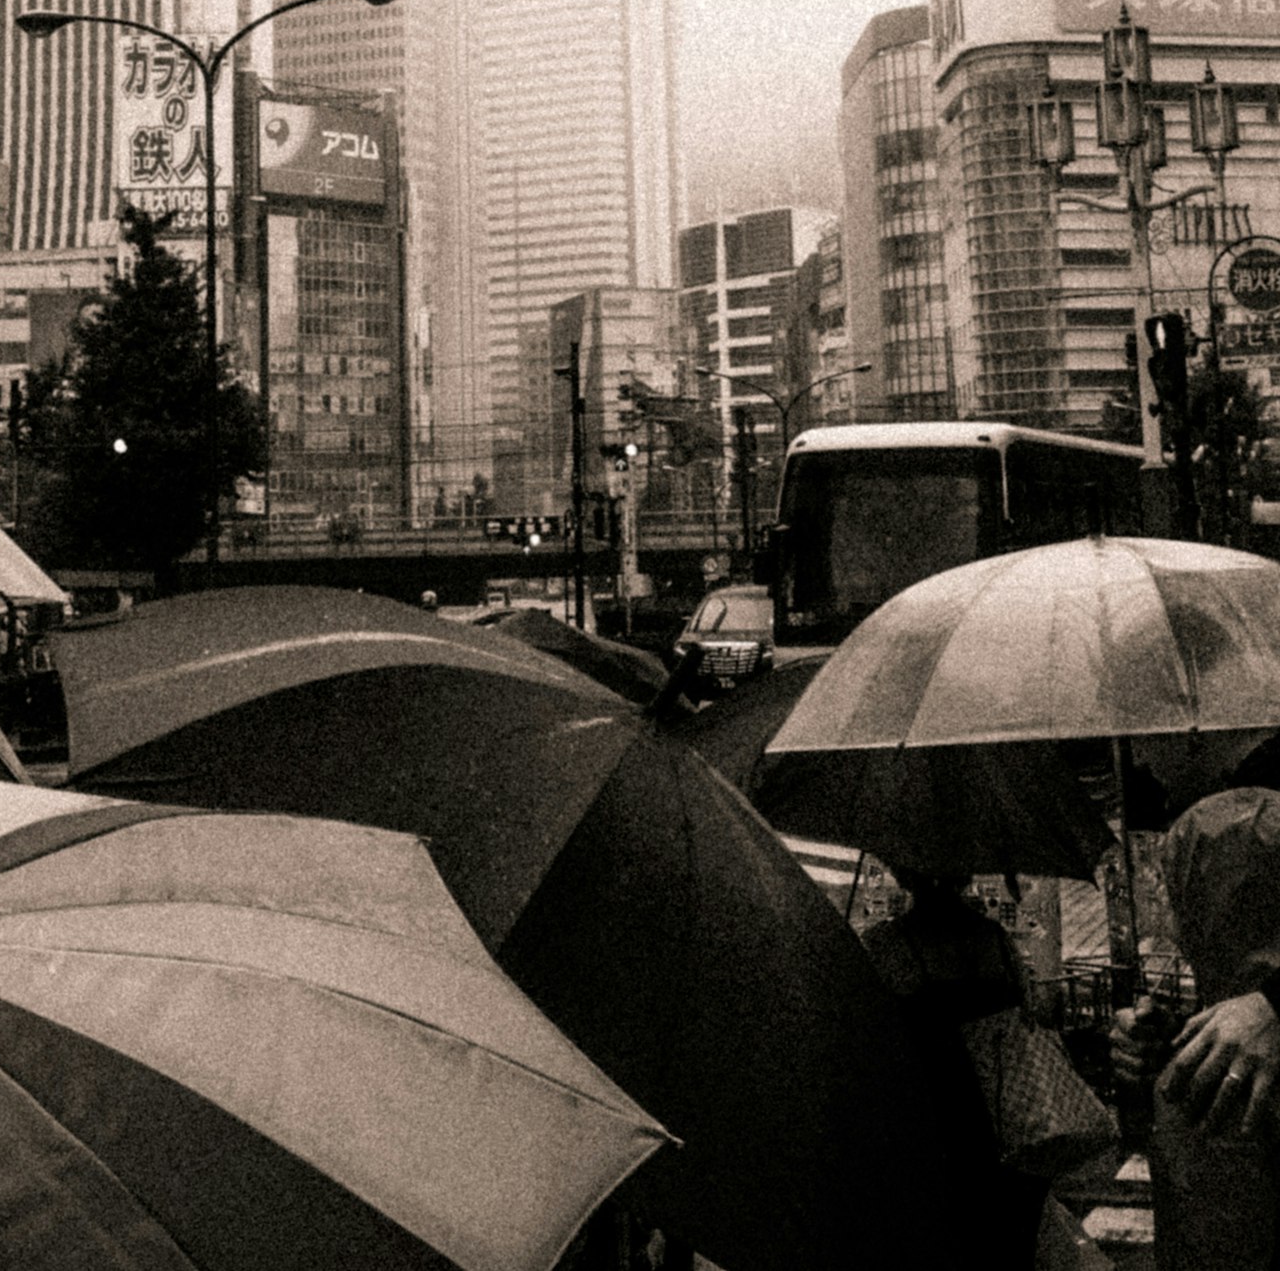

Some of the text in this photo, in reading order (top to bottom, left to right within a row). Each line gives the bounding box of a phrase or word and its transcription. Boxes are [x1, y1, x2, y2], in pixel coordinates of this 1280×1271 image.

[164, 96, 187, 128] の
[322, 130, 380, 160] アコム
